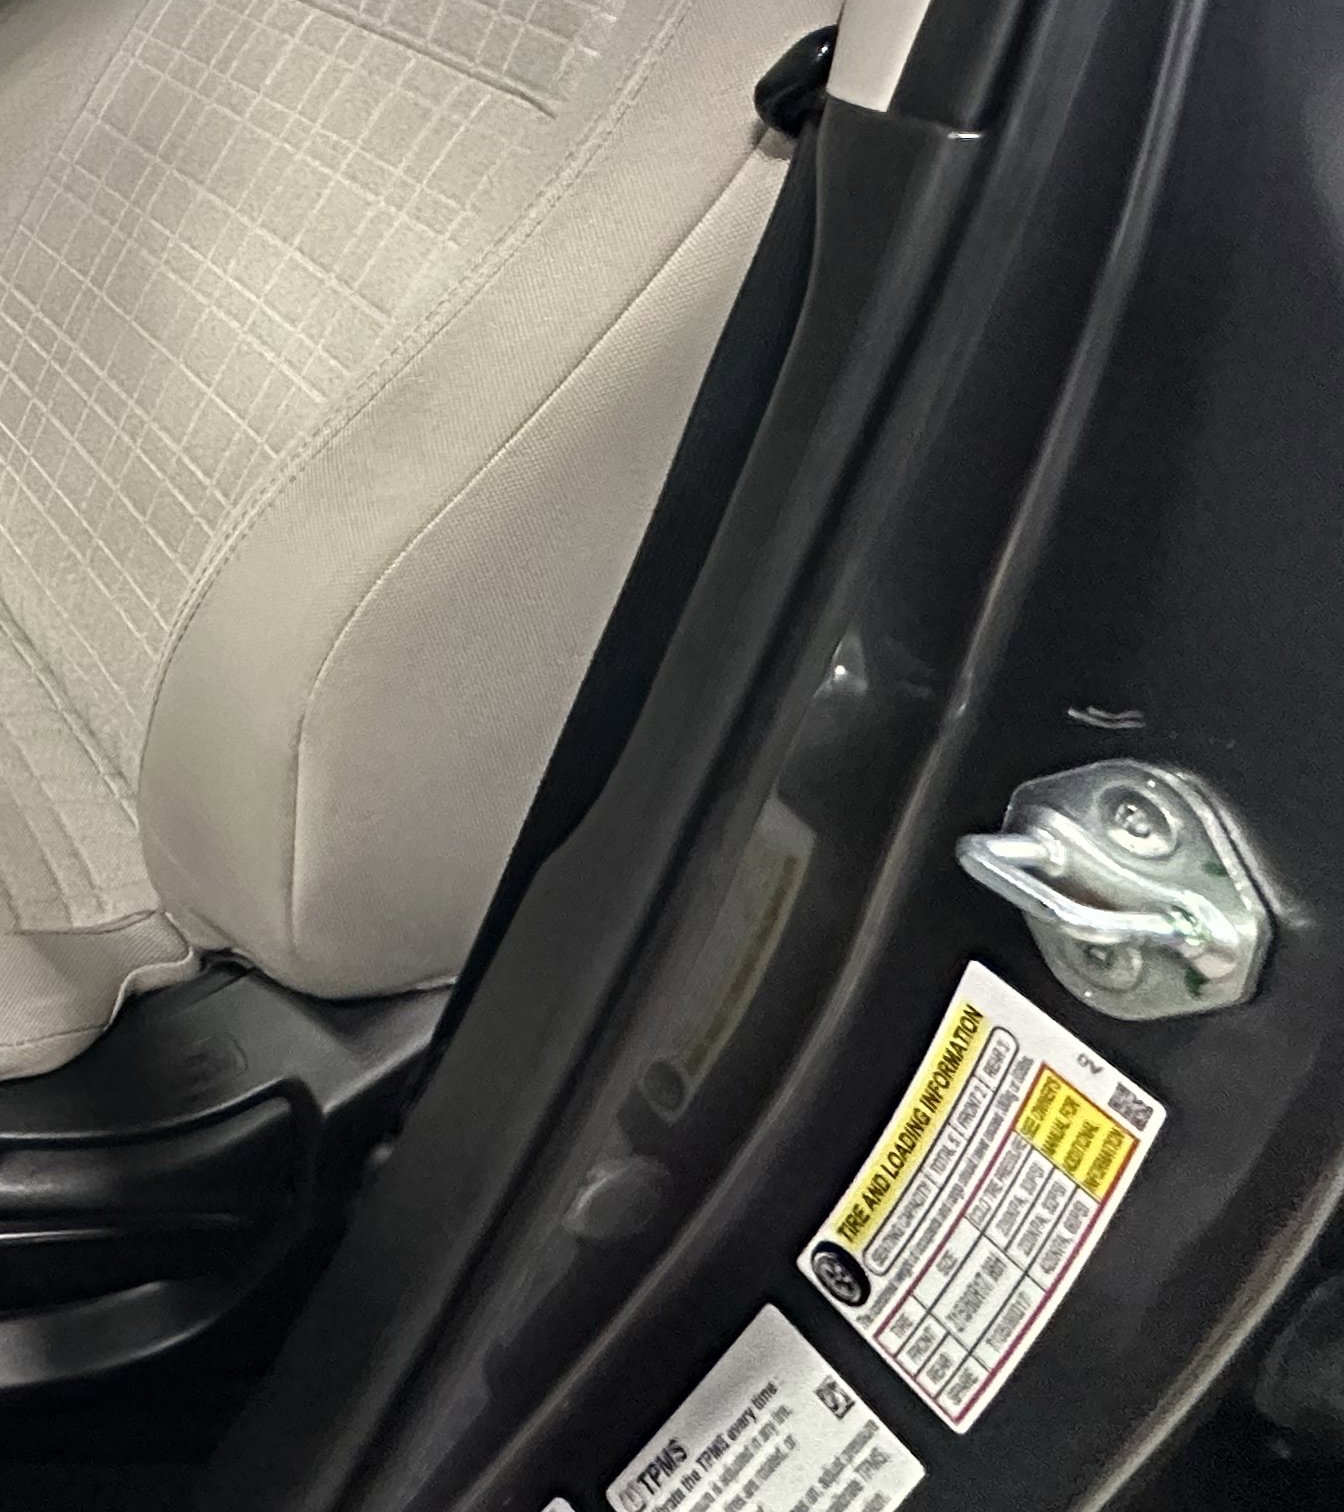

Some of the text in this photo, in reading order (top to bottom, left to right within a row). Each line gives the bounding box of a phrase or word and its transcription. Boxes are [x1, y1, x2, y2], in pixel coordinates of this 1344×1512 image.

[837, 1004, 983, 1243] TIRE AND LOADING INFORMATION
[957, 1092, 981, 1129] FRONT
[636, 1439, 687, 1495] TPMS
[681, 1470, 701, 1492] the
[696, 1434, 730, 1471] TPMS
